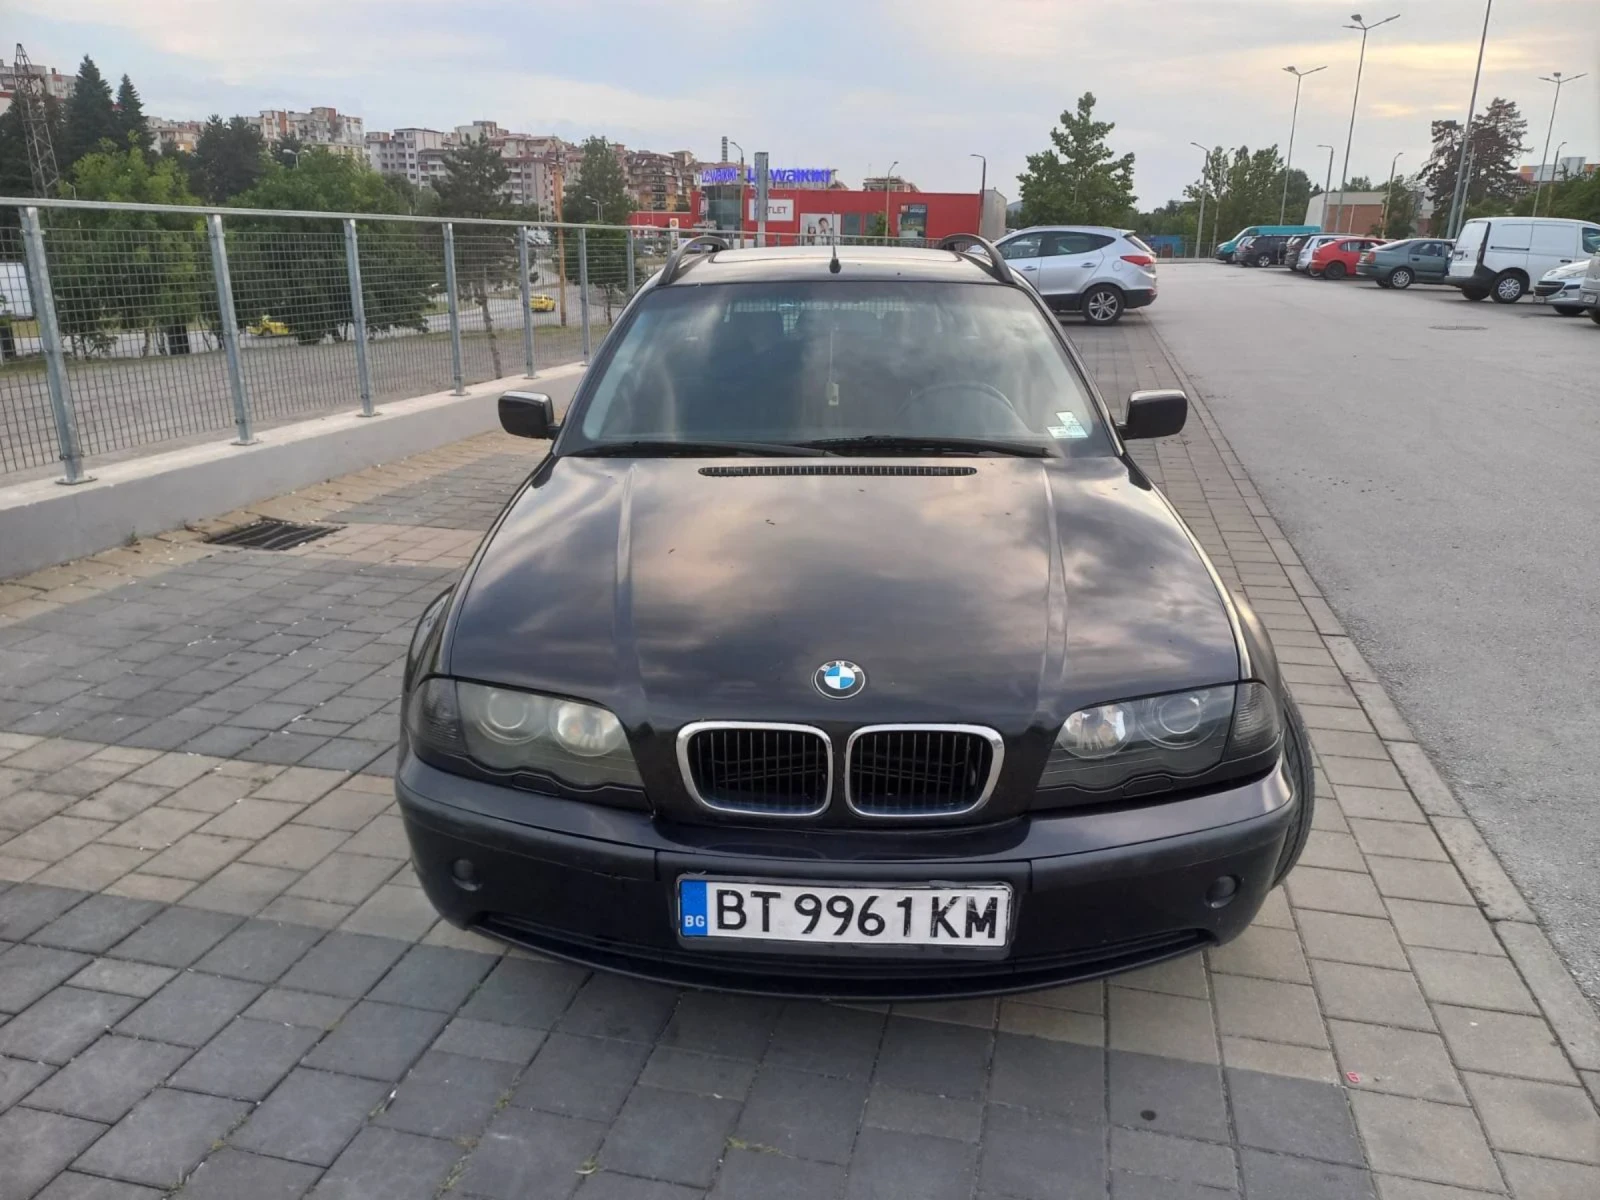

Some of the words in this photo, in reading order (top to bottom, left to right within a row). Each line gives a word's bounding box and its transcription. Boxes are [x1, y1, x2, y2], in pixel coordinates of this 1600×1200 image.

[685, 914, 706, 928] BG
[716, 888, 781, 933] BT
[794, 893, 913, 938] 9961
[929, 895, 998, 939] KM
